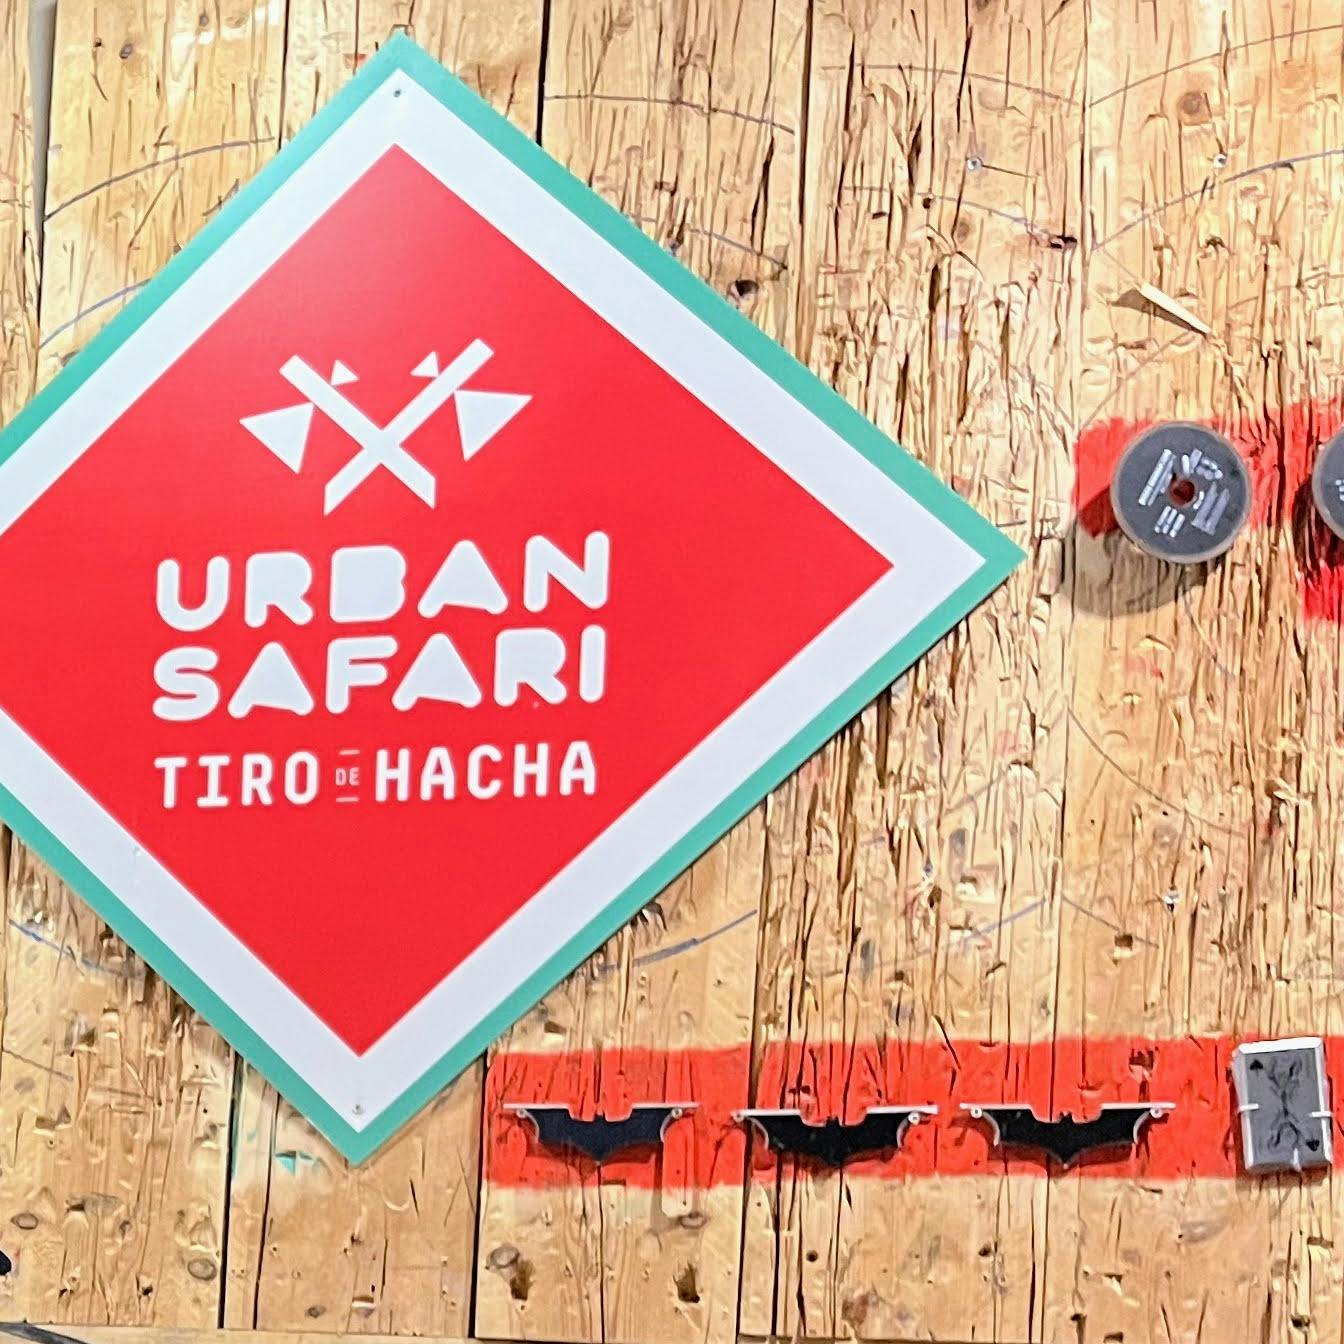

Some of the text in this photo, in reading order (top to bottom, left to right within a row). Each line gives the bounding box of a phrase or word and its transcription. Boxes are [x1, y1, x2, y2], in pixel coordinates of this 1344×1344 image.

[155, 530, 611, 633] URBAN
[152, 624, 607, 722] SAFARI
[153, 740, 597, 809] TIRO DE HACHA
